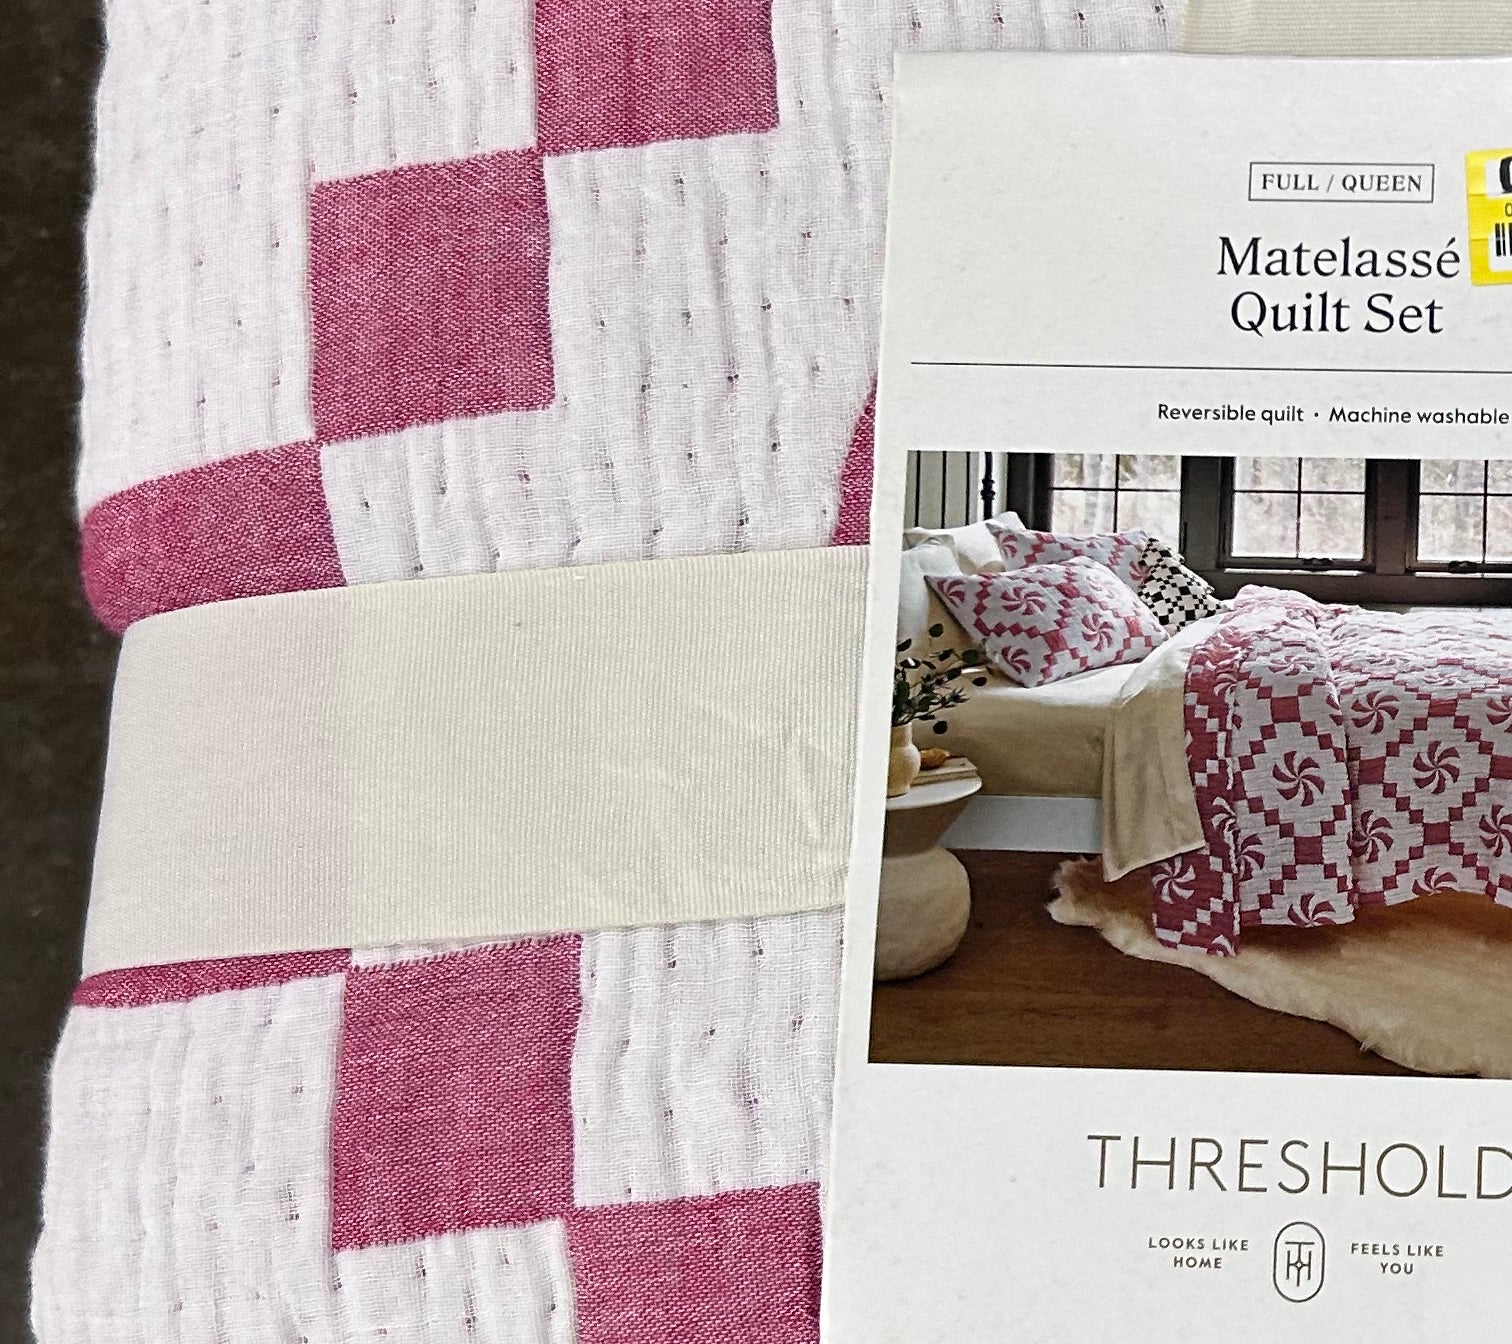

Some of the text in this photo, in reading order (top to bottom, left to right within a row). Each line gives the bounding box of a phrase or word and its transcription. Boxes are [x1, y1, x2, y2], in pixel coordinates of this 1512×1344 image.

[1261, 173, 1320, 191] FULL
[1341, 174, 1422, 193] QUEEN
[1216, 235, 1461, 279] Matelassé
[1230, 290, 1444, 338] Quilt Set
[1158, 403, 1510, 425] Reversible quilt Machine washable
[1148, 1236, 1249, 1252] LOOKS LIKE
[1350, 1242, 1444, 1258] FEELS LIKE
[1173, 1255, 1223, 1270] HOME
[1379, 1261, 1414, 1275] YOU
